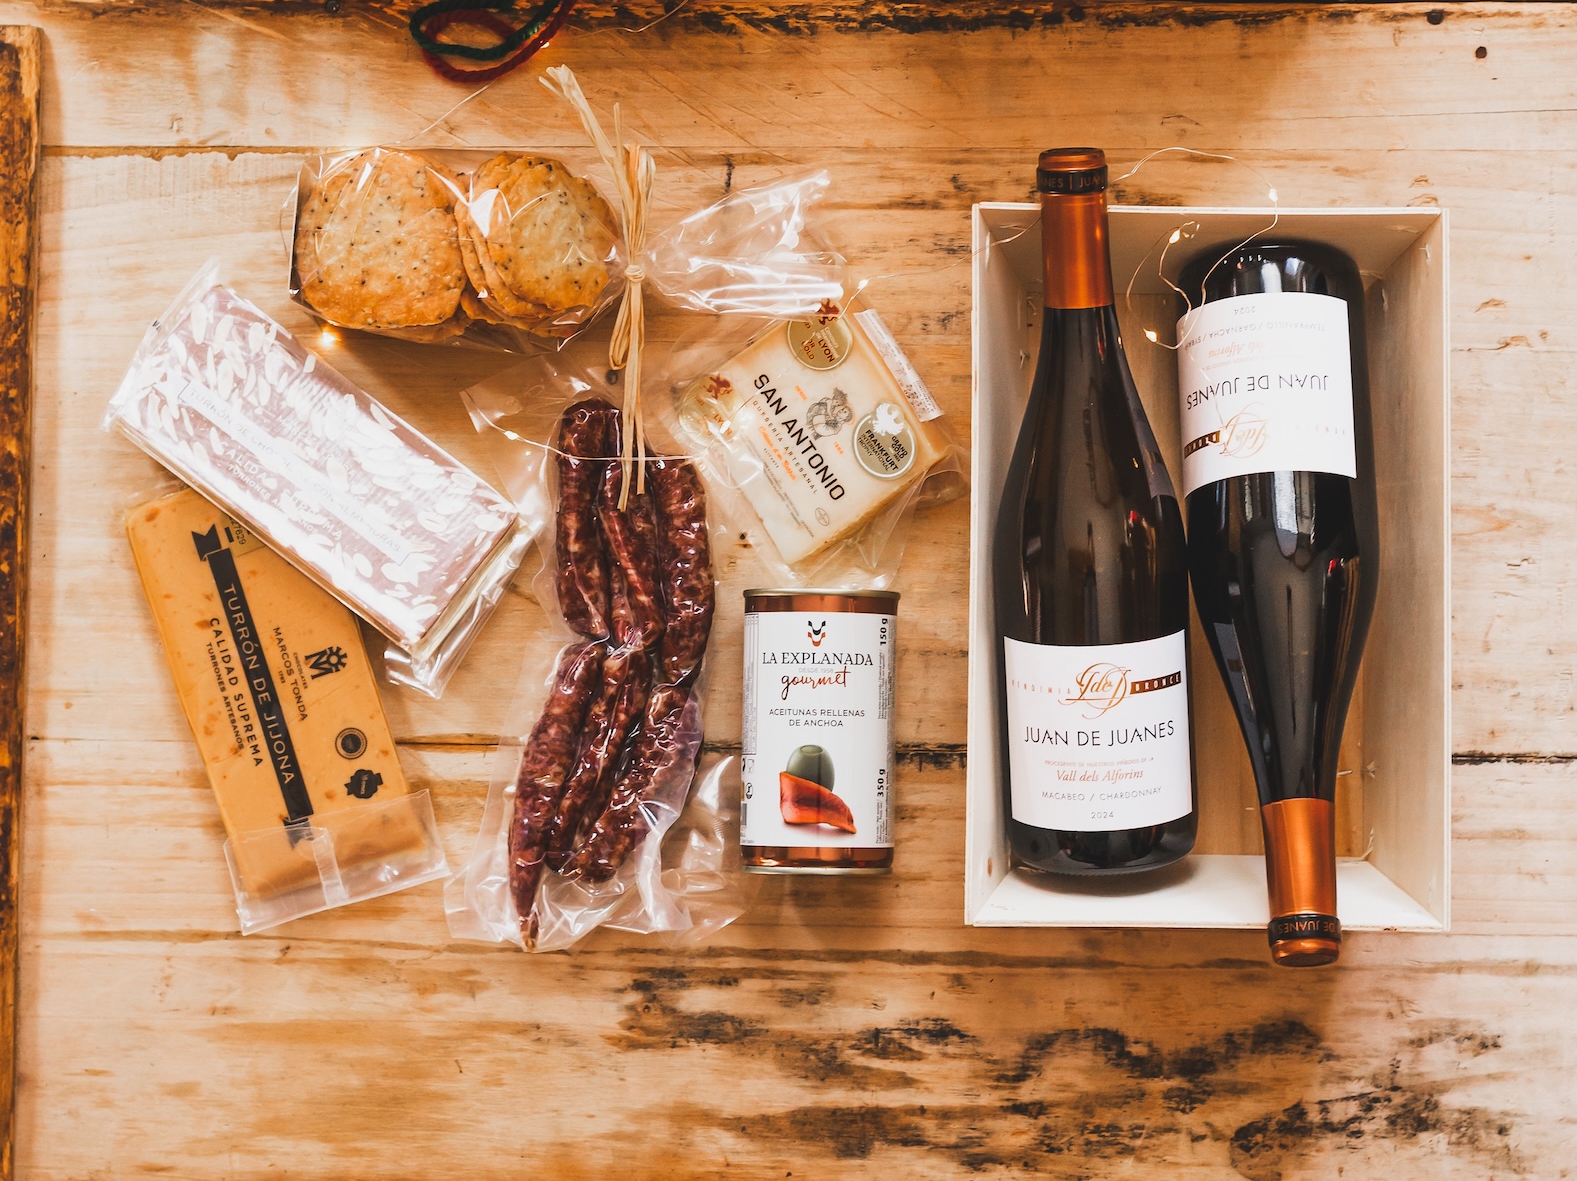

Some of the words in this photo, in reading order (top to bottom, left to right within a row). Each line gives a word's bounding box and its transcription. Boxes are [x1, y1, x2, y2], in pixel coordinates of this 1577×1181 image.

[1234, 305, 1256, 315] 2024
[1209, 322, 1257, 339] GARNACHA
[817, 338, 834, 362] LYON
[1186, 376, 1240, 410] JUANES
[1247, 375, 1270, 392] DE
[1279, 374, 1329, 391] JUAN
[712, 413, 733, 436] LYN
[751, 372, 788, 416] SAN
[780, 414, 847, 502] ANTONIO
[856, 436, 873, 457] TROPHY
[891, 435, 908, 456] GRAND
[860, 433, 889, 471] INTERNATIONAL
[865, 429, 898, 472] FRANKFURT
[890, 442, 904, 459] GOLD
[782, 445, 819, 495] ARTESANAL
[762, 652, 778, 665] LA
[782, 651, 874, 667] EXPLANADA
[221, 582, 264, 670] TURRÓN
[251, 676, 272, 705] DE
[262, 709, 298, 785] JIJONA
[272, 626, 295, 677] MARCOS
[289, 678, 309, 721] TONDA
[780, 665, 852, 701] gourmet
[205, 641, 227, 692] TURRONES
[221, 694, 245, 749] ARTESANOS
[208, 616, 239, 687] CALIDAD
[232, 692, 264, 767] SUPREMA
[769, 708, 818, 717] ACEITUNAS
[820, 708, 865, 718] RELLENAS
[788, 719, 801, 727] DE
[803, 719, 844, 728] ANCHOA
[1024, 726, 1069, 747] JUAN
[1077, 730, 1101, 747] DE
[1107, 719, 1176, 748] JUANES
[1056, 769, 1077, 782] Vall
[1079, 770, 1100, 782] dels
[1101, 769, 1144, 785] Alforins
[1041, 790, 1086, 801] MACABEO
[1099, 786, 1162, 801] CHARDONNAY
[1090, 811, 1115, 819] 2024
[1278, 920, 1321, 934] JUANES
